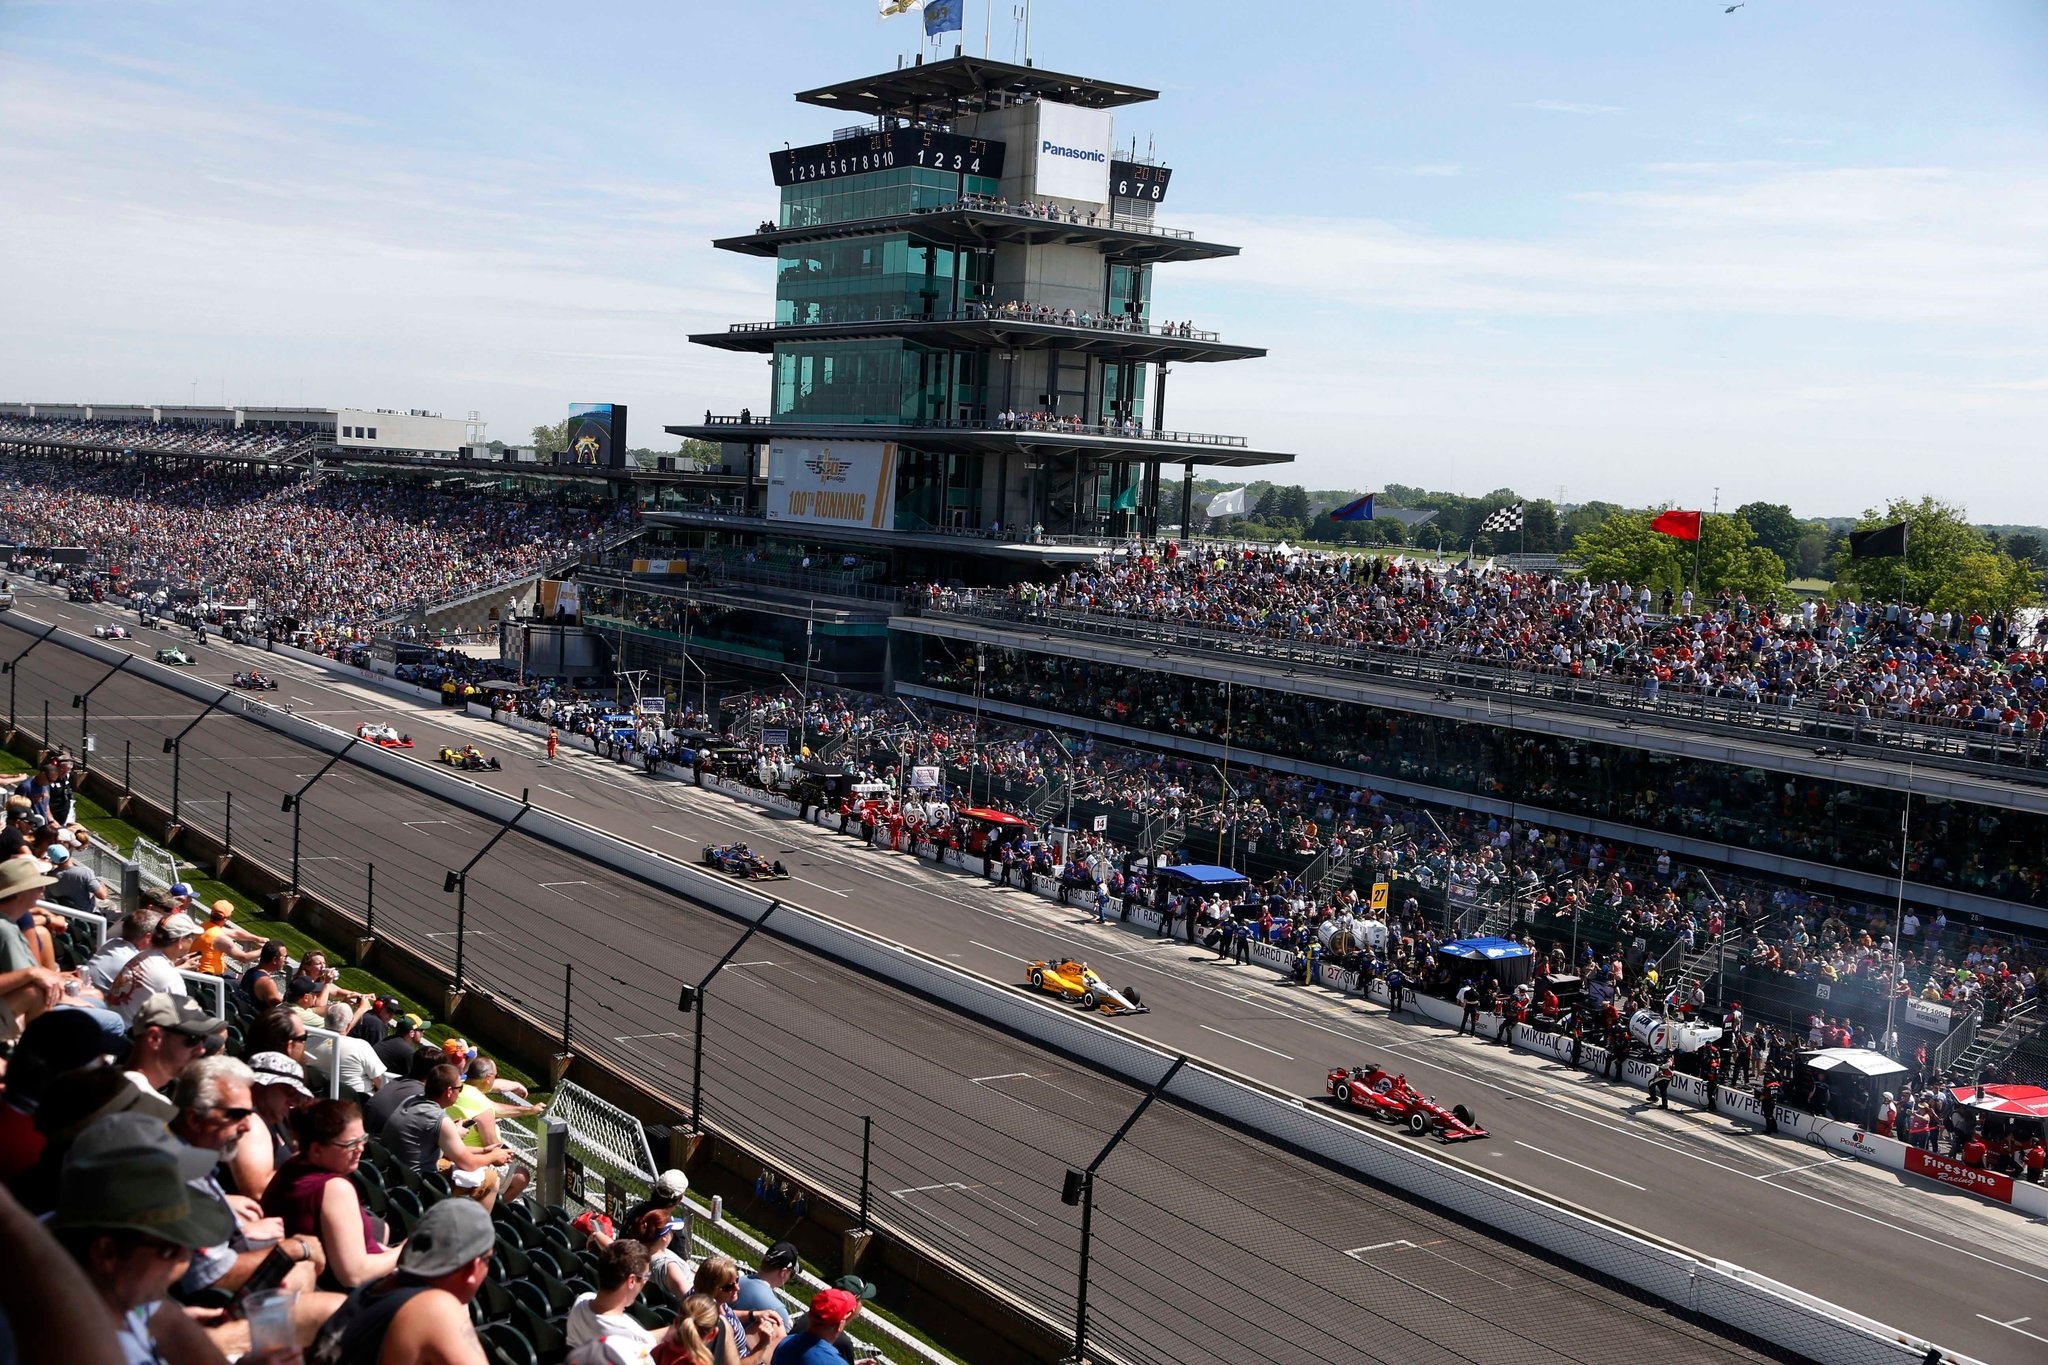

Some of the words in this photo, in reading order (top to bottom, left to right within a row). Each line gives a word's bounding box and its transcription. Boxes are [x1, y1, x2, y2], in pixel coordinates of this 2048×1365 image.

[970, 140, 986, 156] 27
[1042, 141, 1105, 163] Panasonic
[790, 168, 795, 182] 1
[800, 166, 806, 180] 2
[810, 164, 816, 178] 3
[820, 162, 826, 176] 4
[830, 161, 836, 174] 5
[840, 159, 847, 173] 6
[851, 157, 857, 171] 7
[862, 156, 869, 170] 8
[874, 154, 880, 168] 9
[882, 151, 894, 166] 10
[917, 150, 925, 164] 1
[934, 152, 943, 167] 2
[953, 154, 962, 169] 3
[970, 158, 980, 172] 4
[1119, 180, 1128, 194] 6
[1136, 183, 1144, 196] 7
[1152, 186, 1160, 199] 8
[788, 490, 815, 516] 100TH
[814, 491, 867, 521] RUNNING
[744, 788, 752, 797] 42
[1096, 820, 1104, 828] 14
[1041, 878, 1056, 892] SATO
[1070, 888, 1082, 900] ABC
[1373, 889, 1386, 902] 27
[1253, 945, 1281, 962] MARCO
[1328, 968, 1340, 980] 27
[1818, 988, 1828, 998] 29
[1520, 1026, 1562, 1052] MIKHAIL
[1654, 1032, 1664, 1045] 7
[1628, 1062, 1652, 1079] SMP
[1922, 1154, 1996, 1187] Firestone
[1937, 1172, 1974, 1186] Racing
[572, 1172, 582, 1198] 26
[613, 1198, 624, 1225] 25
